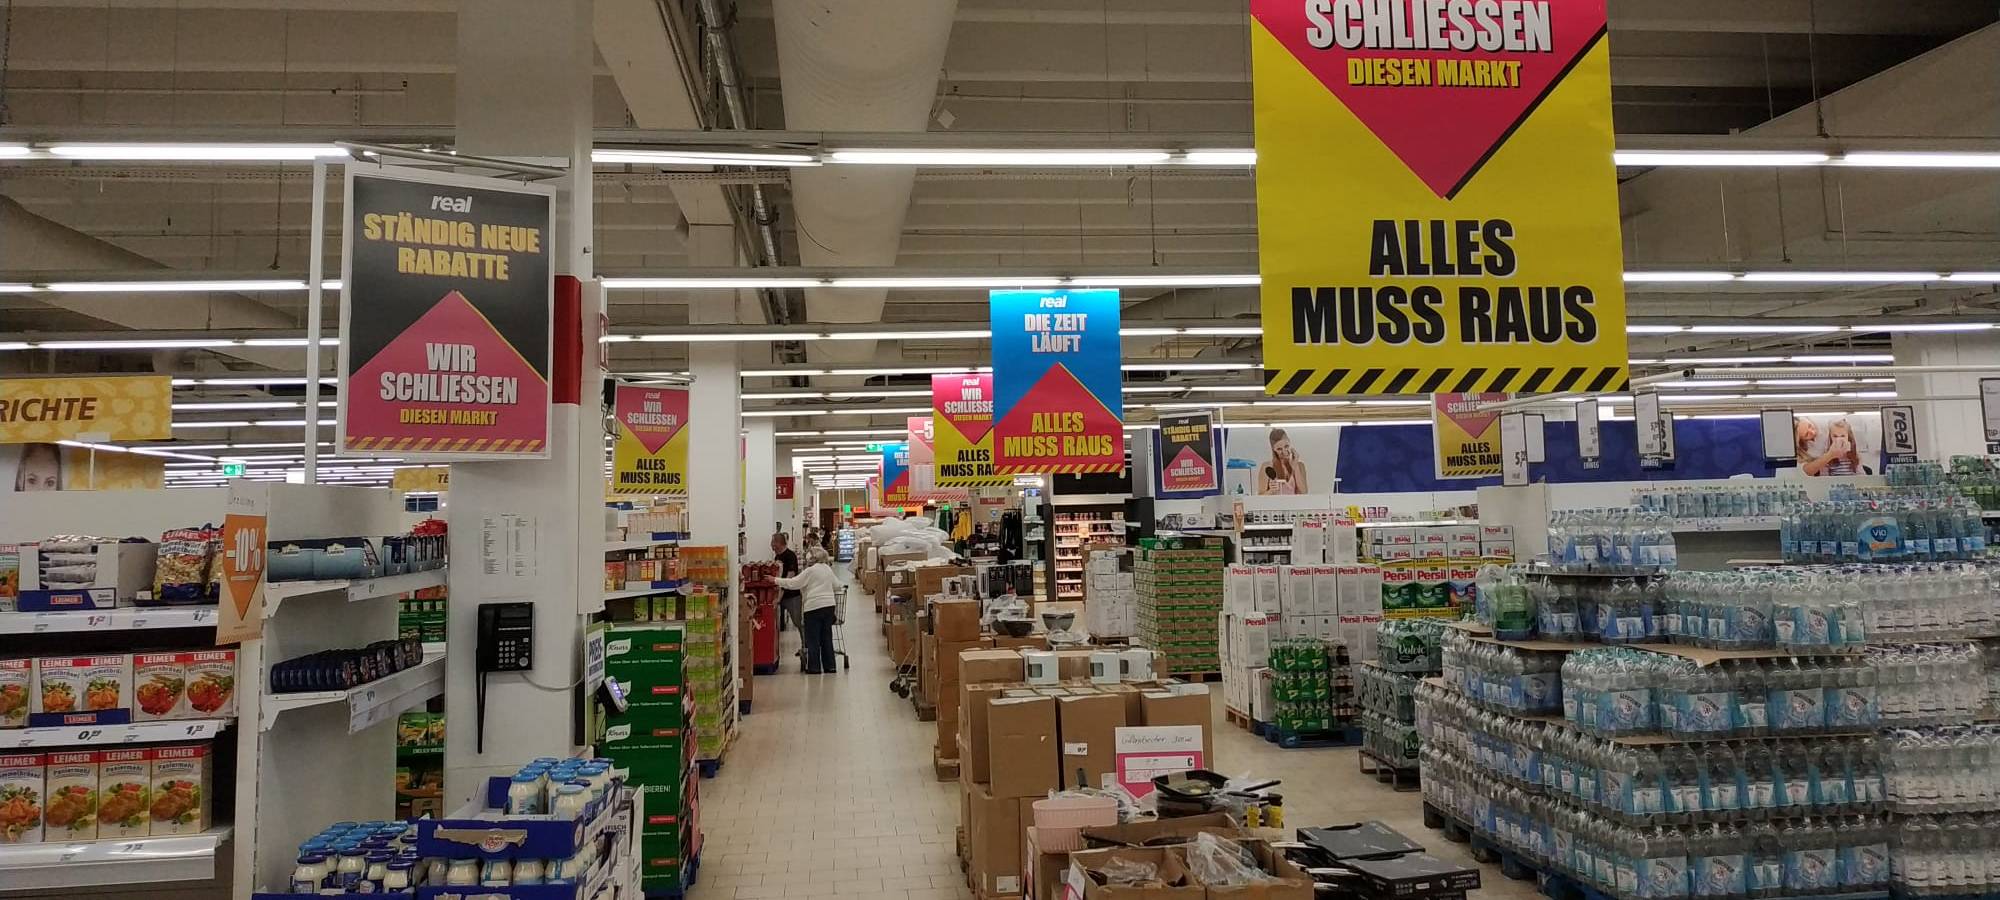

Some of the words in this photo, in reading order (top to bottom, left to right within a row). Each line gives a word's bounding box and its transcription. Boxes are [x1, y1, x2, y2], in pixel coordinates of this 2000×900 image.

[1305, 0, 1554, 52] SCHLIESSEN
[1347, 57, 1432, 87] DIESEN
[1437, 59, 1522, 88] MARKT
[431, 195, 473, 213] real
[363, 211, 476, 249] STÄNDIG
[480, 223, 541, 254] NEUE
[1368, 218, 1517, 277] ALLES
[397, 247, 509, 281] RABATTE
[1039, 295, 1067, 309] real
[1291, 285, 1447, 345] MUSS
[1458, 285, 1598, 344] RAUS
[1024, 313, 1051, 332] DIE
[1053, 312, 1088, 332] ZEIT
[1031, 332, 1081, 353] LÄUFT
[425, 342, 477, 374] WIR
[380, 371, 519, 405] SCHLIESSEN
[962, 377, 980, 387] real
[961, 387, 982, 401] WIR
[643, 401, 662, 413] WIR
[944, 400, 994, 414] SCHLIESSE
[400, 408, 448, 426] DIESEN
[450, 409, 499, 428] MARKT
[627, 411, 678, 426] SCHLIESSEN
[1031, 411, 1085, 434] ALLES
[912, 420, 934, 440] -5
[1892, 410, 1913, 450] real
[1003, 435, 1060, 458] MUSS
[1063, 434, 1114, 457] RAUS
[1461, 442, 1491, 454] ALLES
[957, 449, 990, 463] ALLES
[1446, 455, 1480, 467] MUSS
[1479, 454, 1501, 466] RAU
[636, 458, 666, 471] ALLES
[940, 464, 974, 477] MUSS
[977, 463, 995, 477] RA
[438, 473, 448, 484] TE
[620, 471, 651, 484] MUSS
[653, 472, 681, 485] RAUS
[1302, 520, 1322, 529] Persil
[1335, 519, 1356, 528] Persil
[226, 527, 261, 573] -10%
[1257, 567, 1277, 575] Persil
[1290, 568, 1311, 576] Persil
[1314, 567, 1334, 575] Persil
[1338, 567, 1358, 575] Persil
[1383, 570, 1413, 581] Persil
[1417, 570, 1447, 580] Persil
[1451, 569, 1477, 579] Persi
[1245, 617, 1267, 626] Persil
[1266, 614, 1281, 623] rsil
[1340, 616, 1361, 624] Persil
[1398, 644, 1426, 655] Volvic
[143, 655, 176, 664] LEIMER
[193, 652, 226, 661] LEIMER
[0, 660, 25, 669] EIMER
[41, 659, 73, 668] LEIMER
[54, 753, 91, 764] LEIMER
[106, 751, 143, 761] LEIMER
[158, 748, 194, 759] LEIMER
[0, 757, 37, 766] LEIMER
